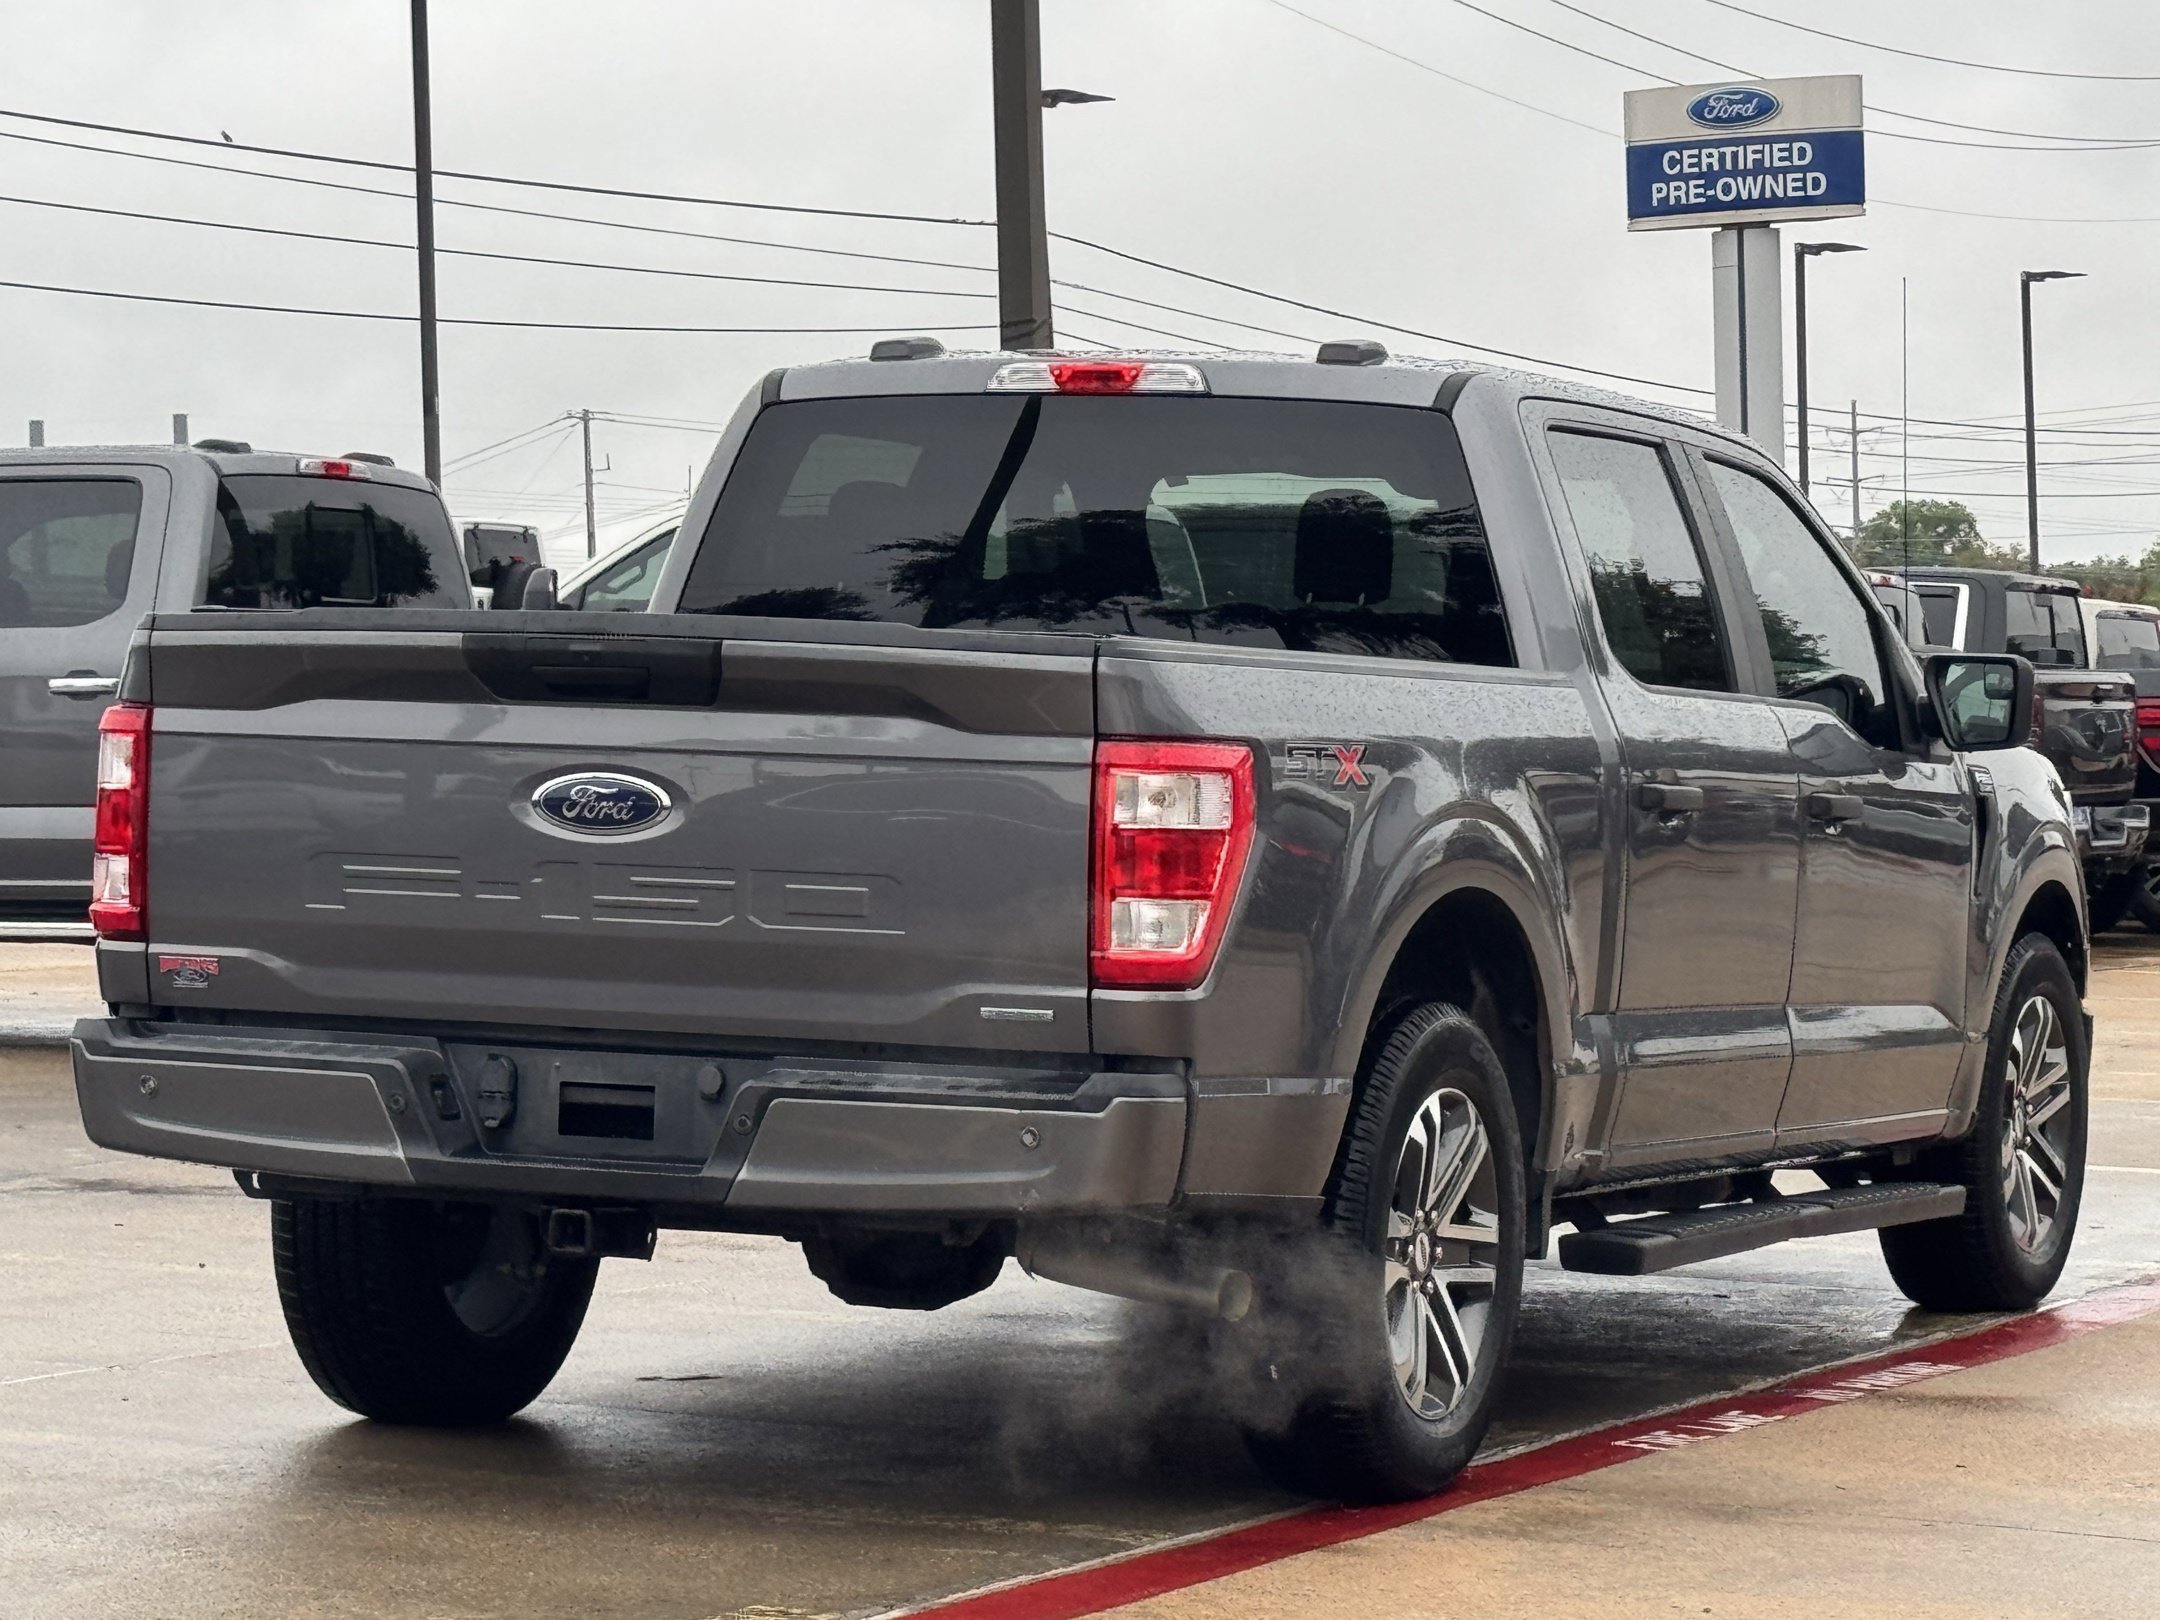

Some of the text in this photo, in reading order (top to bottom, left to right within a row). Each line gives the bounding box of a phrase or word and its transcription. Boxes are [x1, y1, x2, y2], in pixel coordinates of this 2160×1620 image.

[1703, 93, 1760, 120] Ford
[1662, 141, 1814, 176] CERTIFIED
[1651, 171, 1828, 207] PRE-OWNED
[1285, 742, 1370, 788] STX
[562, 784, 637, 821] Ford
